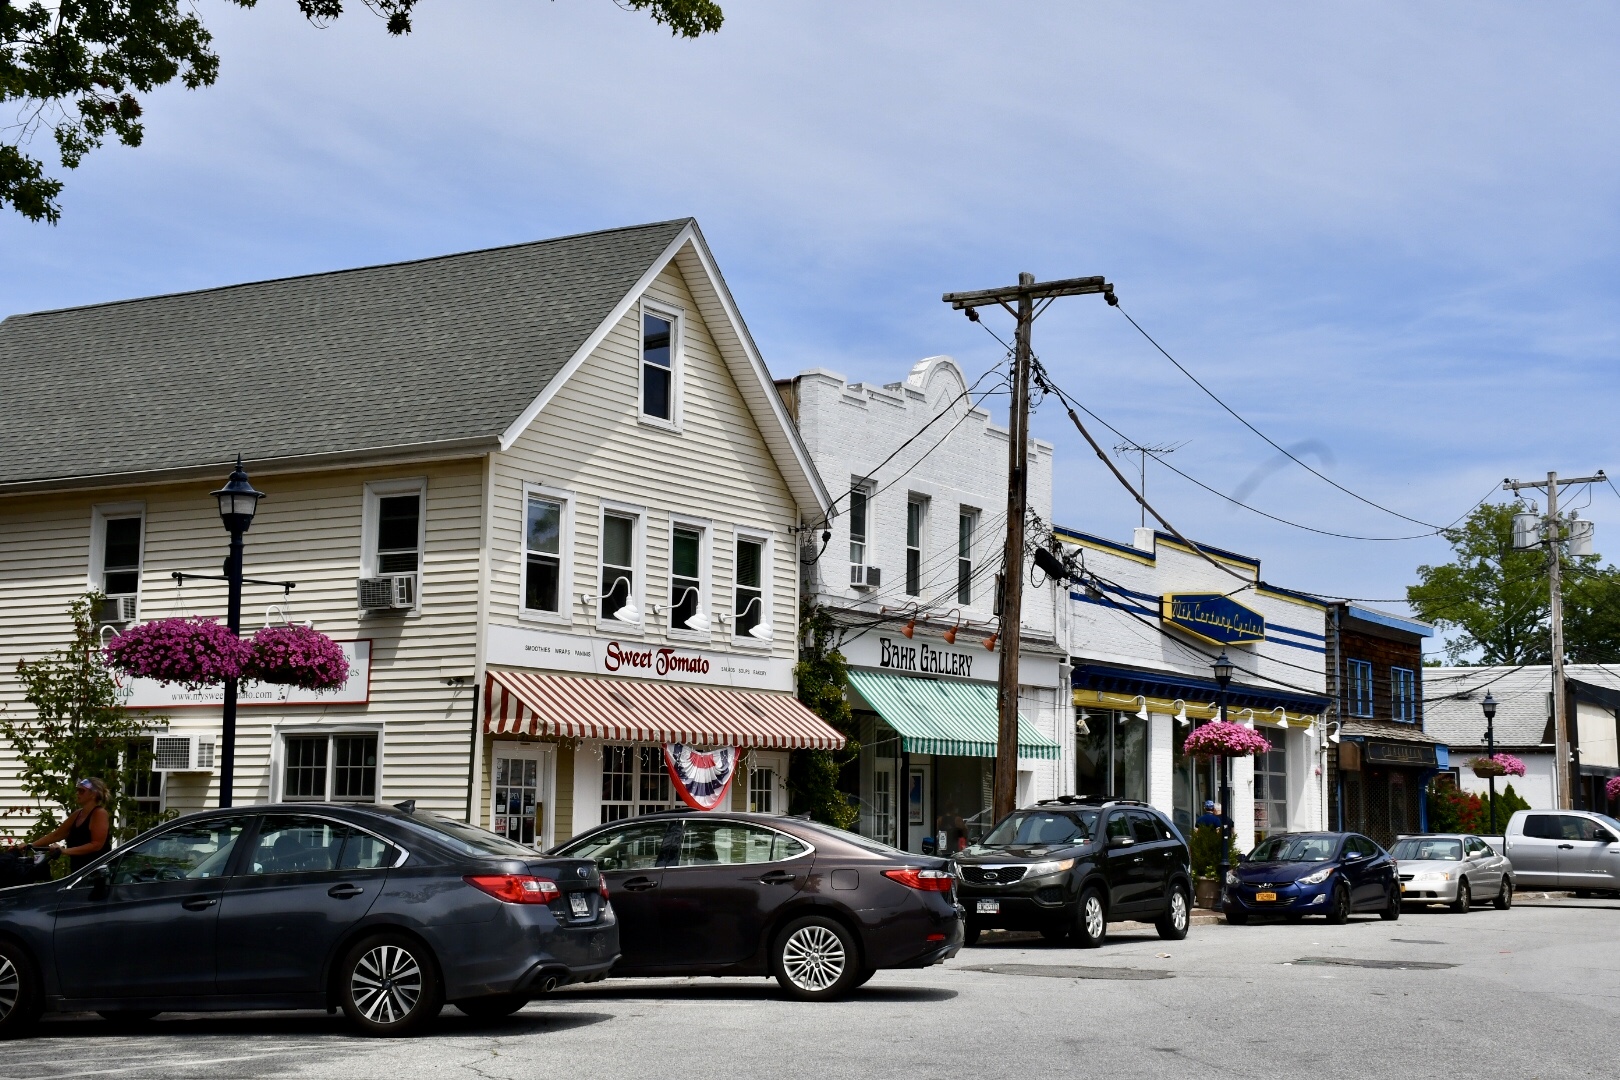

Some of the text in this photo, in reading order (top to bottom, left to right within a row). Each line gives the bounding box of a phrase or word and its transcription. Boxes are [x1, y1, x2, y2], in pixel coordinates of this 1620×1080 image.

[1194, 603, 1233, 634] Century
[1233, 613, 1264, 638] Cycles
[524, 644, 592, 658] SMOOTHIES WRAPS PANINIS
[604, 641, 710, 676] Sweet Tomato
[879, 637, 973, 677] BAHR GALLERY
